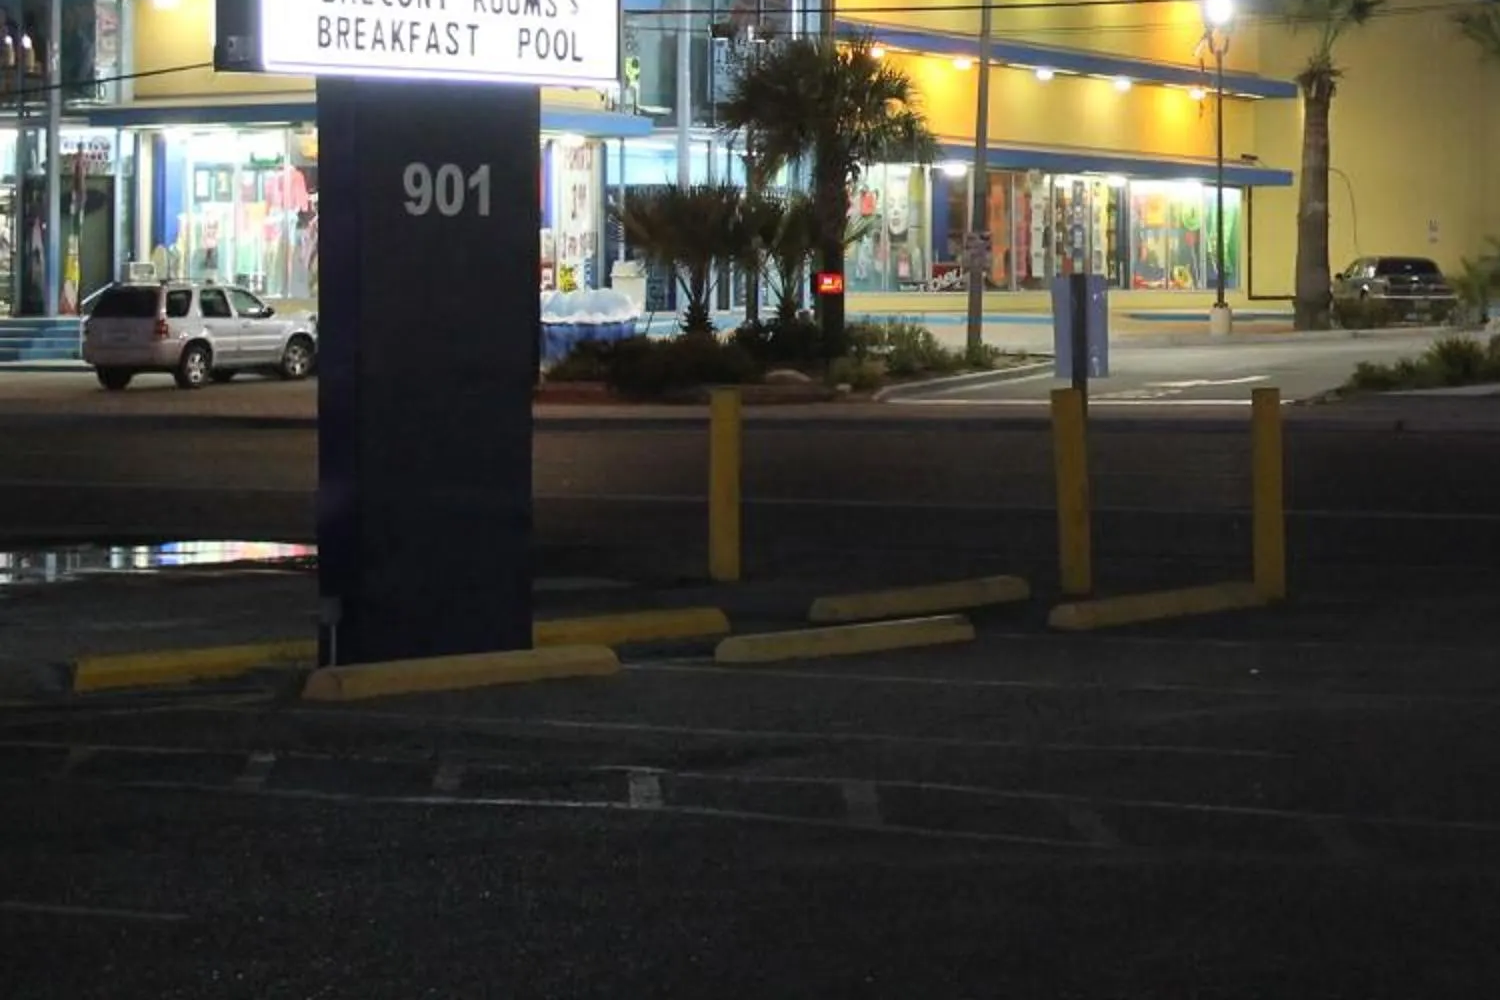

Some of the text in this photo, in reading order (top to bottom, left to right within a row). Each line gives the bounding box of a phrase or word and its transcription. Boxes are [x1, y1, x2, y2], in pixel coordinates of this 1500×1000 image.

[317, 14, 584, 62] BREAKFAST POOL
[403, 161, 490, 216] 901
